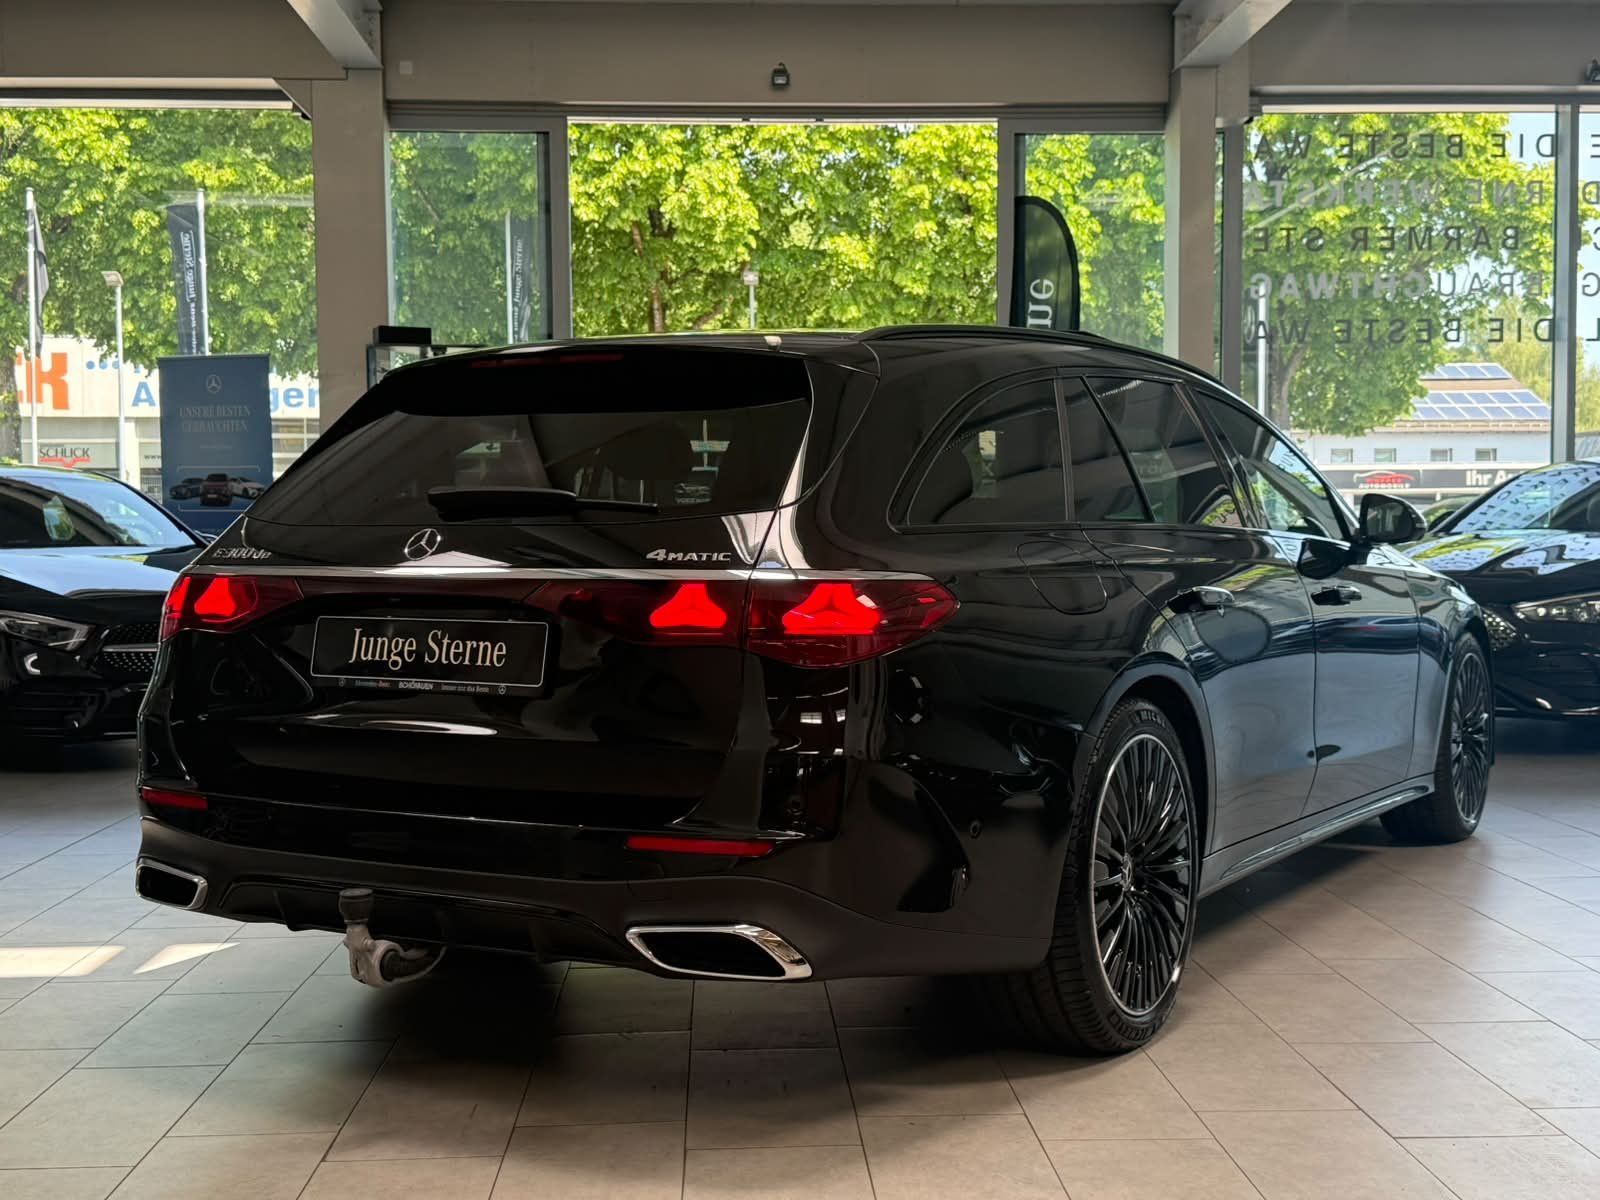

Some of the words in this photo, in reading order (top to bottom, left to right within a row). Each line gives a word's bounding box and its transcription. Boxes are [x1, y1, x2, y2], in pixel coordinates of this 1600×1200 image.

[39, 447, 90, 458] SCHLICK
[1466, 470, 1492, 486] Ihr
[645, 548, 732, 561] 4MATIC
[349, 628, 417, 671] Junge
[424, 630, 507, 667] Sterne
